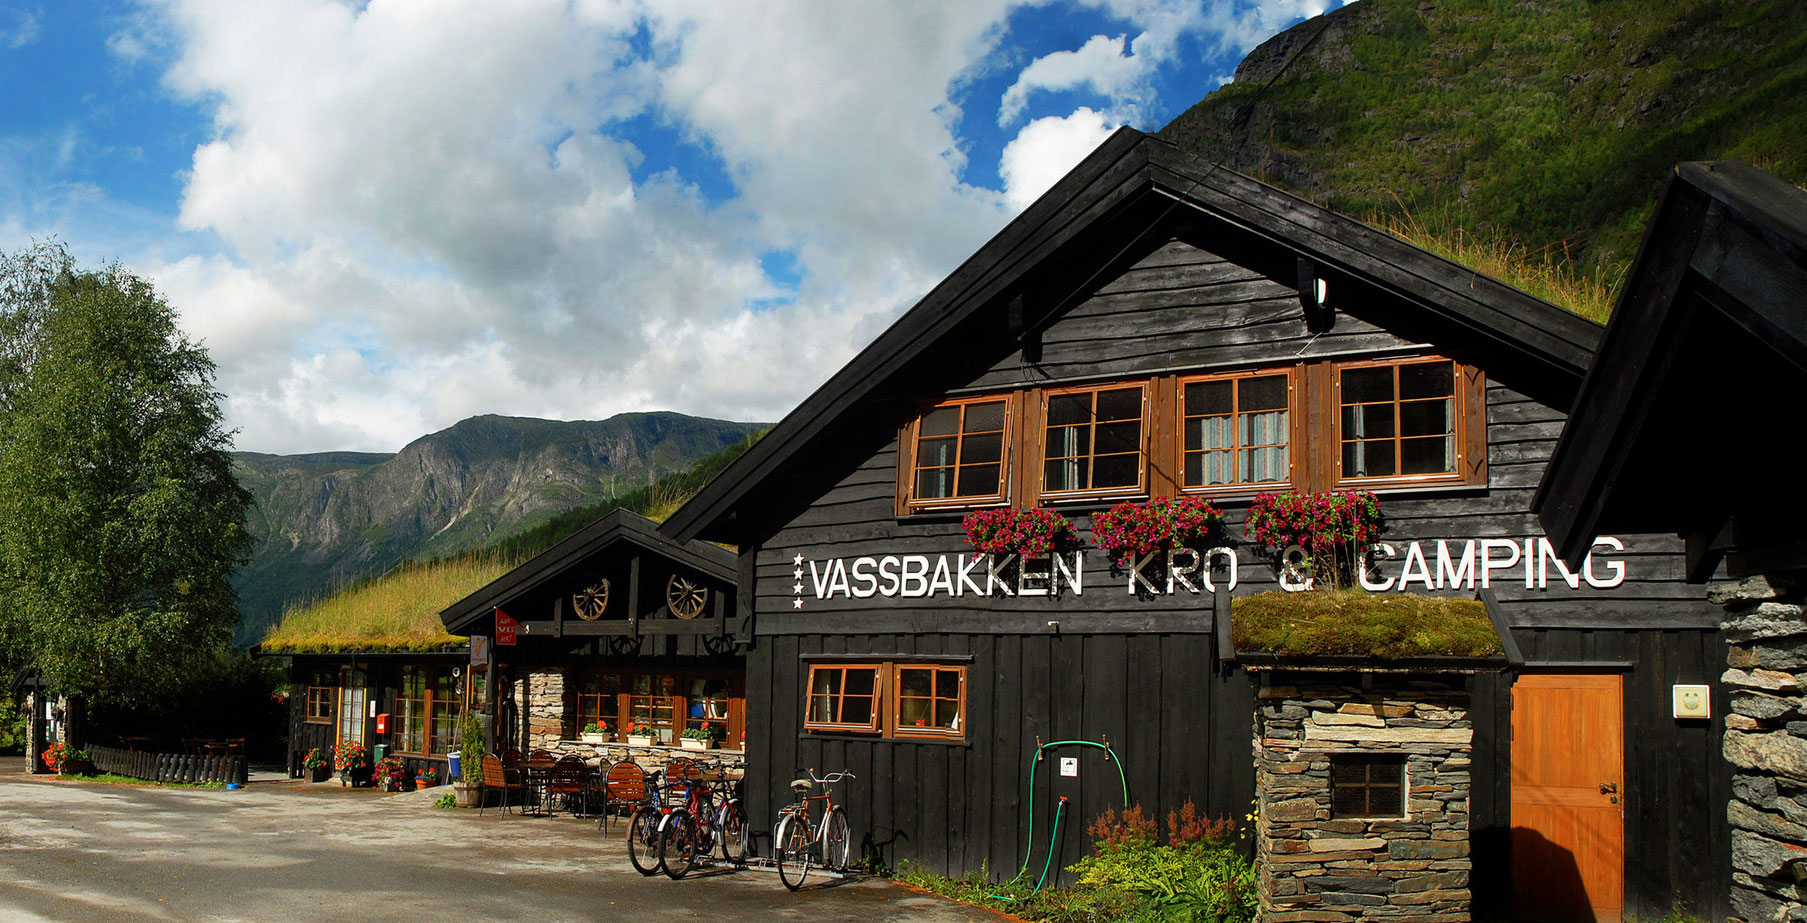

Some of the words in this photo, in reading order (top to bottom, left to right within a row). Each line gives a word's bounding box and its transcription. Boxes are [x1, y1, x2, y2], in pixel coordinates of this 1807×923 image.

[809, 551, 1083, 599] VASSBAKKEN
[1128, 547, 1238, 594] KRO
[1279, 544, 1315, 592] &
[1359, 536, 1627, 592] CAMPING
